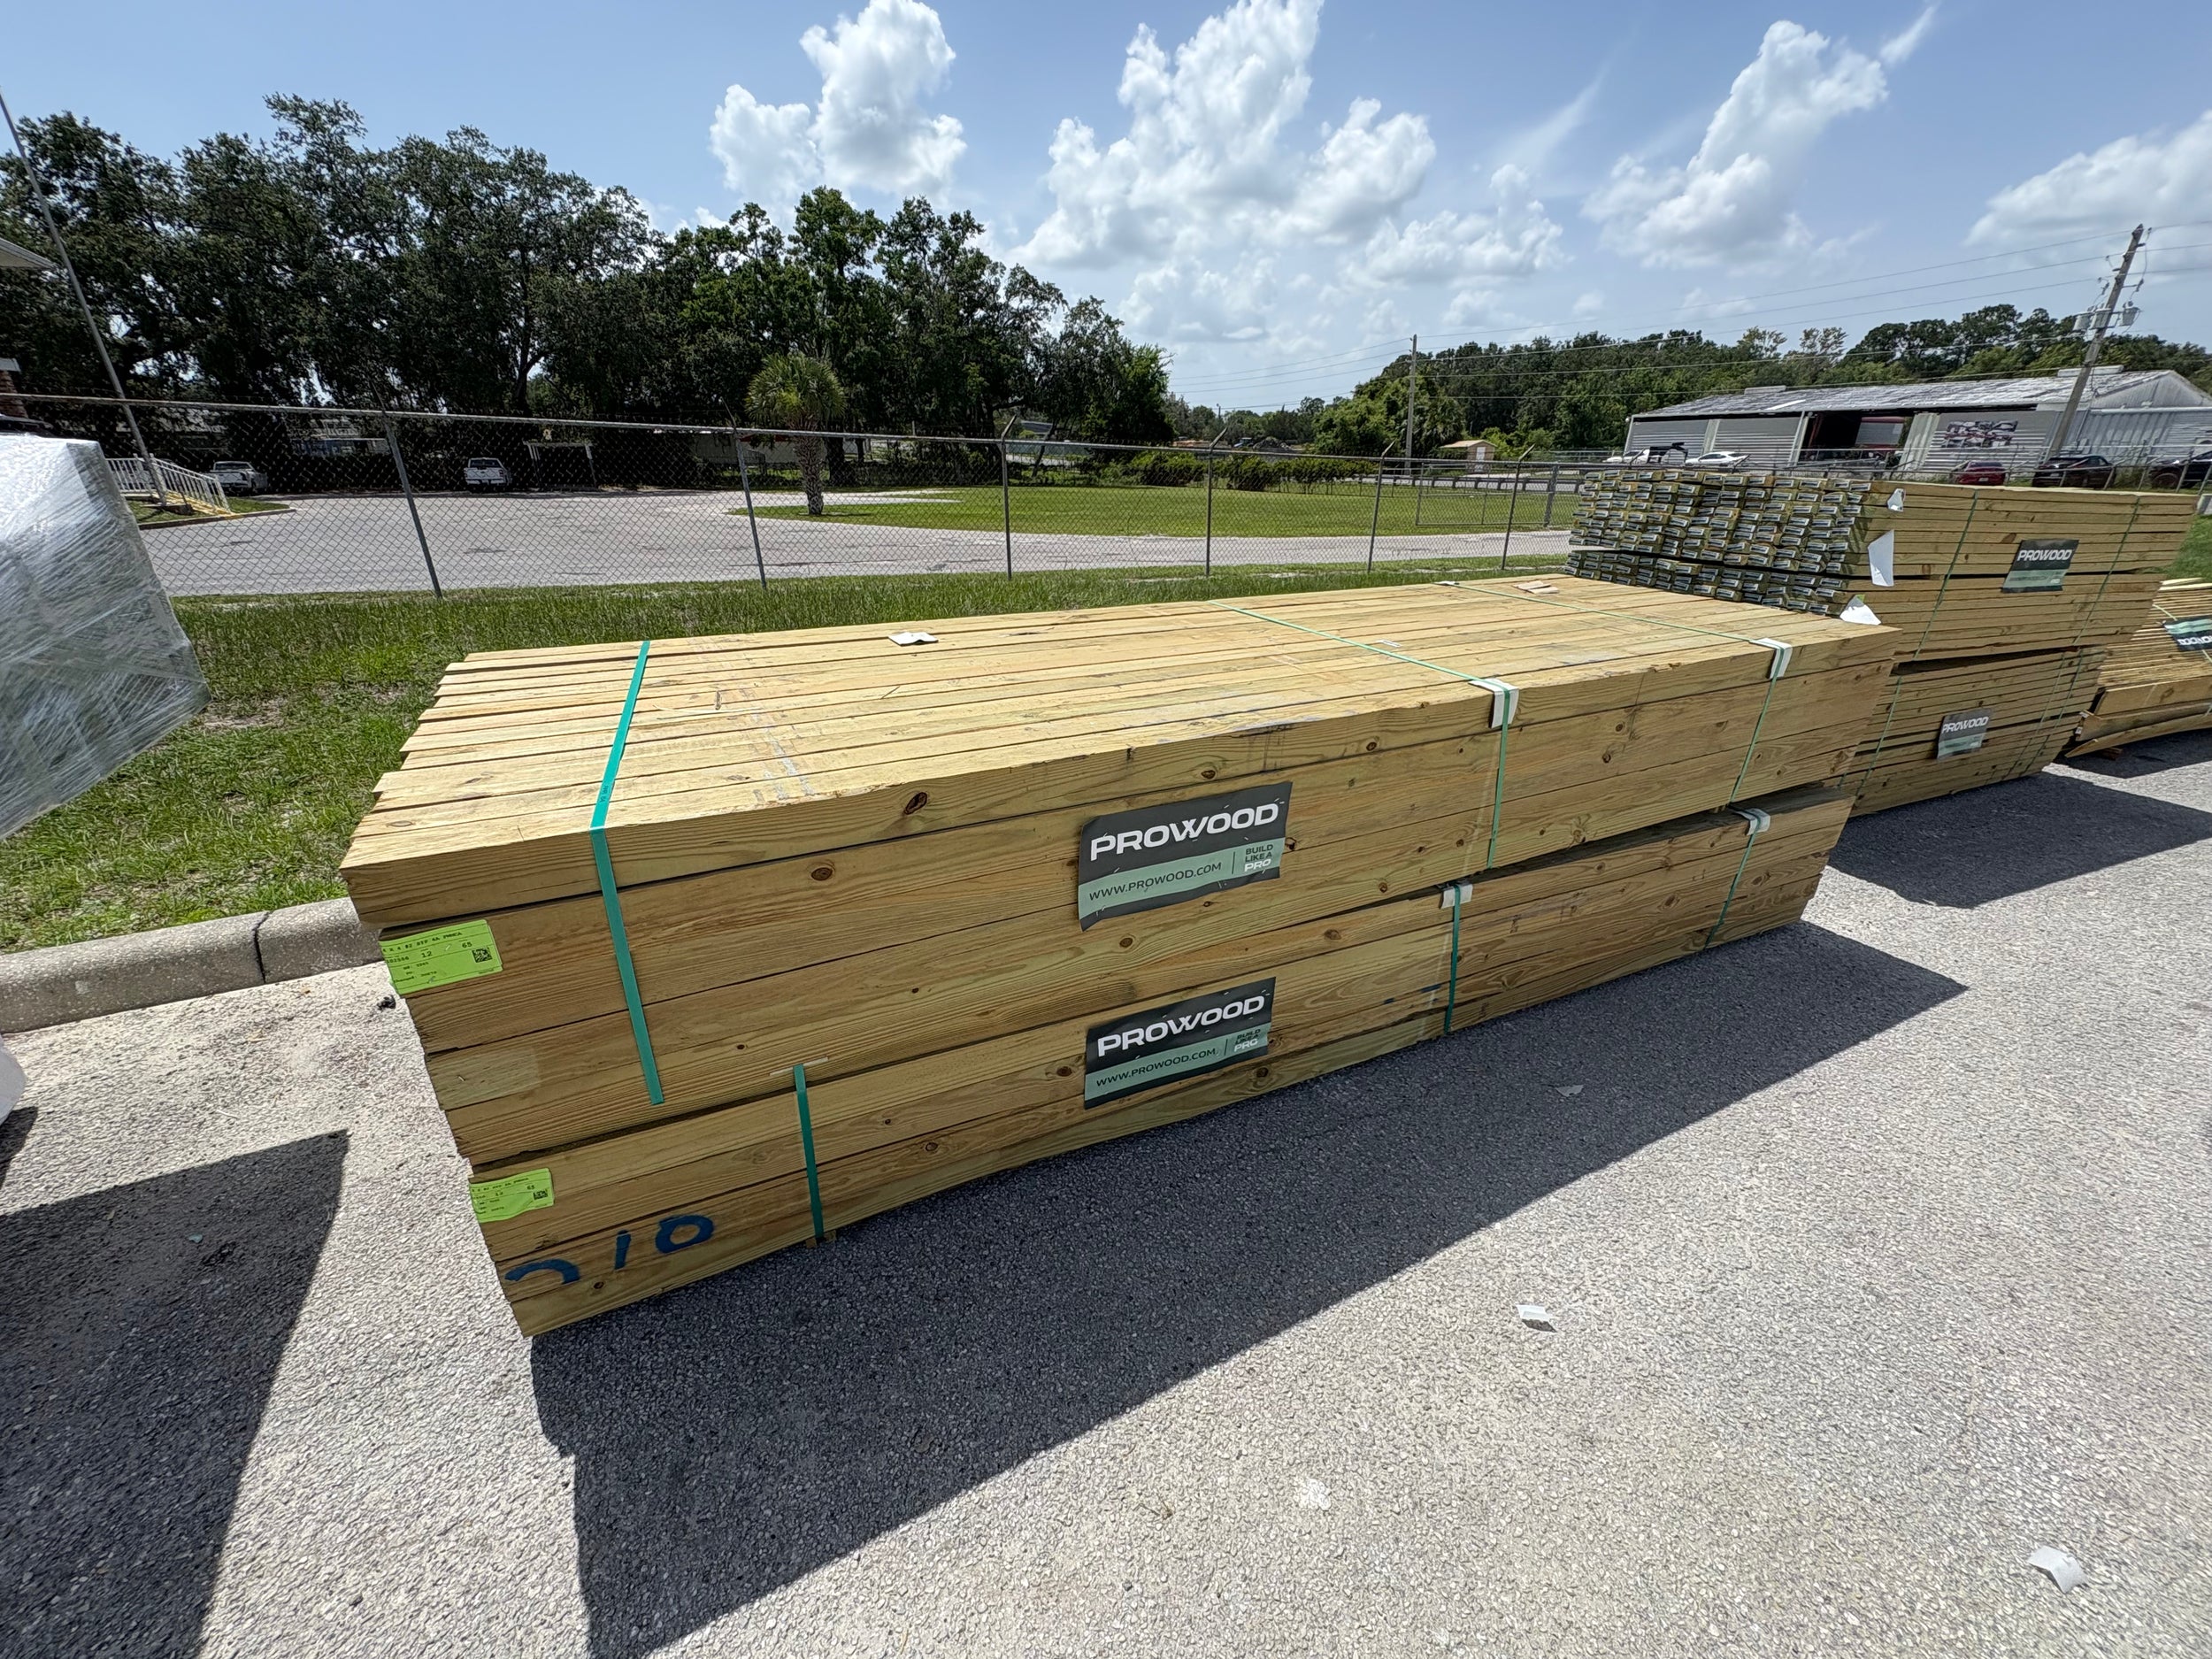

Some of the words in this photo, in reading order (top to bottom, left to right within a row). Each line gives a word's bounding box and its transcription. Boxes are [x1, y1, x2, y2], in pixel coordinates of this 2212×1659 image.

[2017, 549, 2072, 561] PROWOOD
[1942, 717, 1989, 733] PROWOOD
[1091, 803, 1279, 861] PROWOOD
[1246, 844, 1273, 855] BUILD
[1244, 858, 1271, 872] PRO
[1245, 854, 1264, 862] LIKE
[1089, 862, 1222, 901] WWW.PROWOOD.COM
[1097, 996, 1265, 1057] PROWOOD
[1096, 1048, 1216, 1087] WWW.PROWOOD.COM
